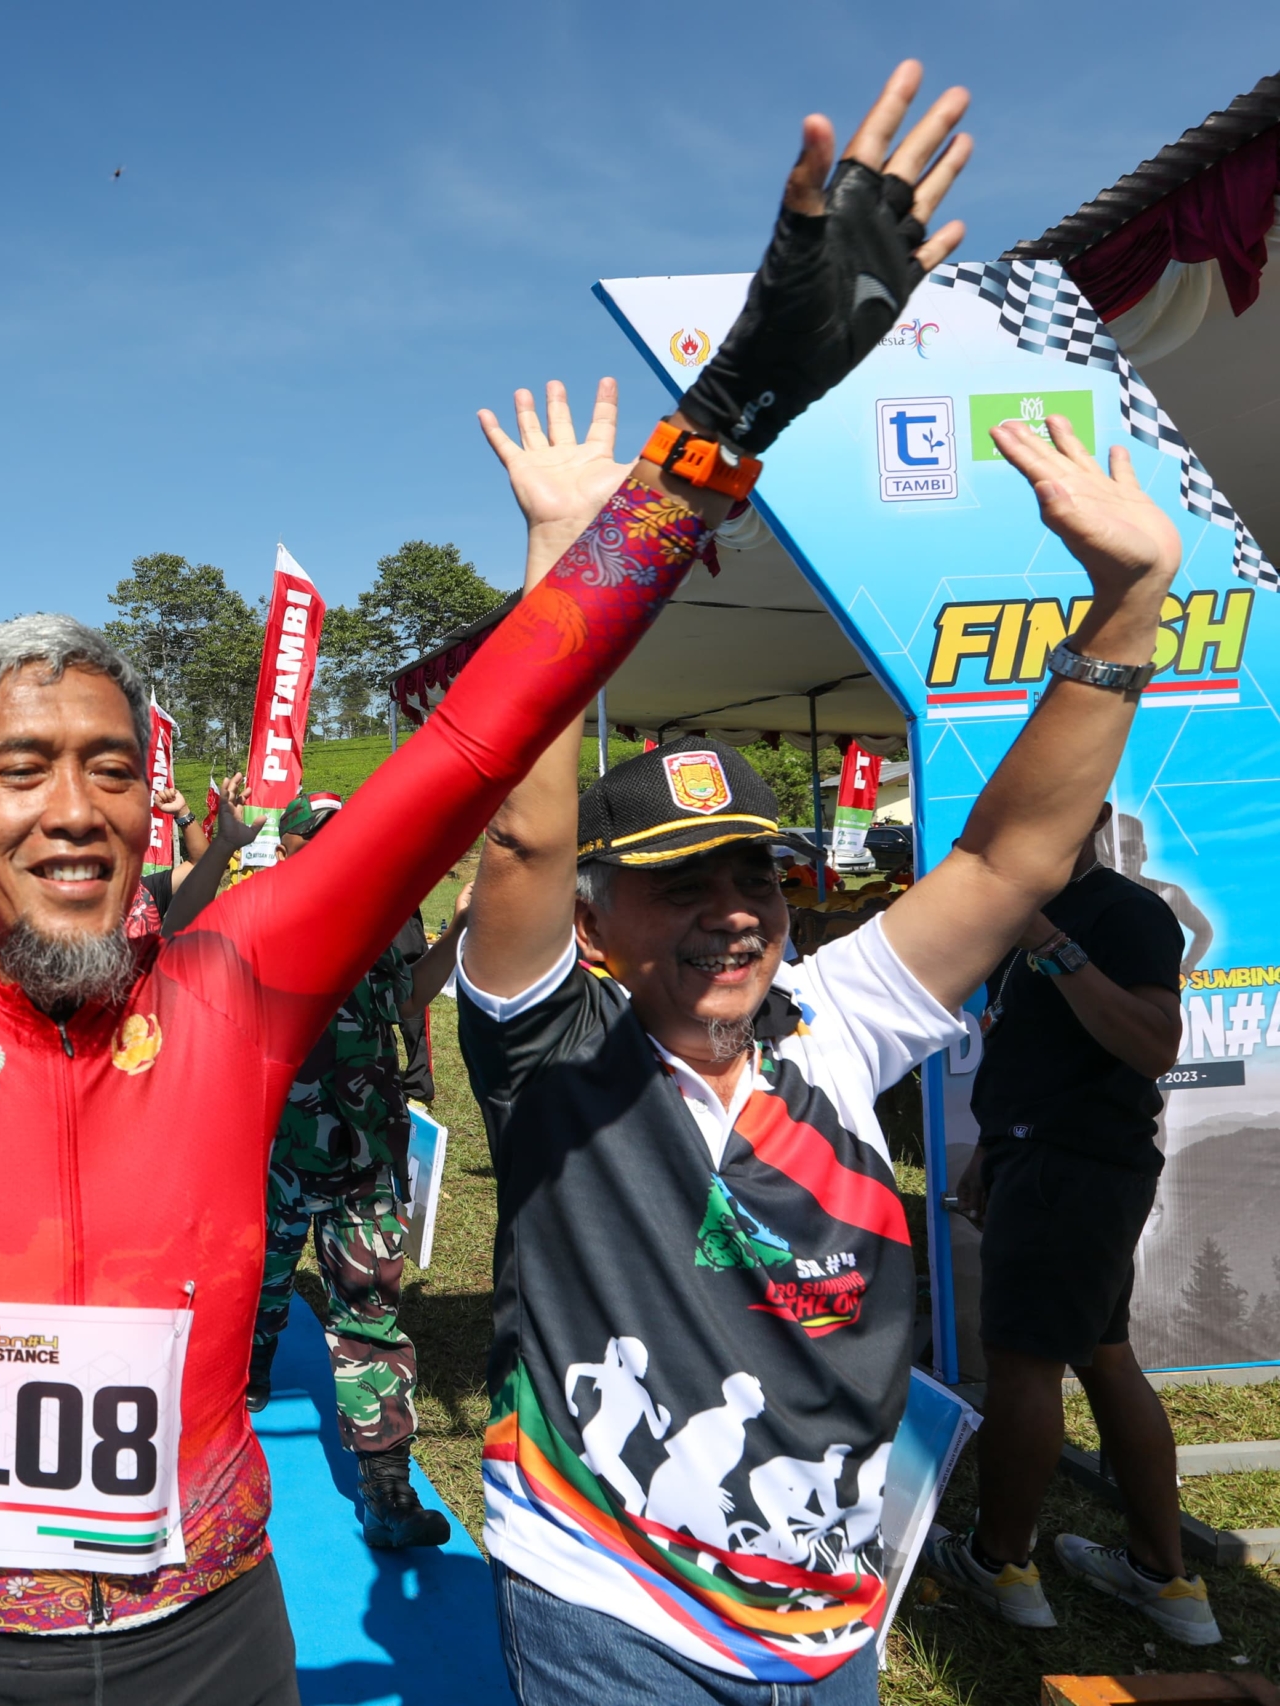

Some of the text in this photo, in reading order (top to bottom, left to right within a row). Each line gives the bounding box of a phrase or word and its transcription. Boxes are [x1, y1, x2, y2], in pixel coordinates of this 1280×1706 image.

[892, 479, 946, 493] TAMBI
[270, 588, 313, 722] TAMBI
[925, 587, 1255, 688] FINH
[262, 729, 293, 782] PT
[853, 750, 871, 790] PT
[149, 812, 164, 848] PT
[1189, 965, 1280, 990] SUMBIN
[1164, 1071, 1198, 1084] 2023
